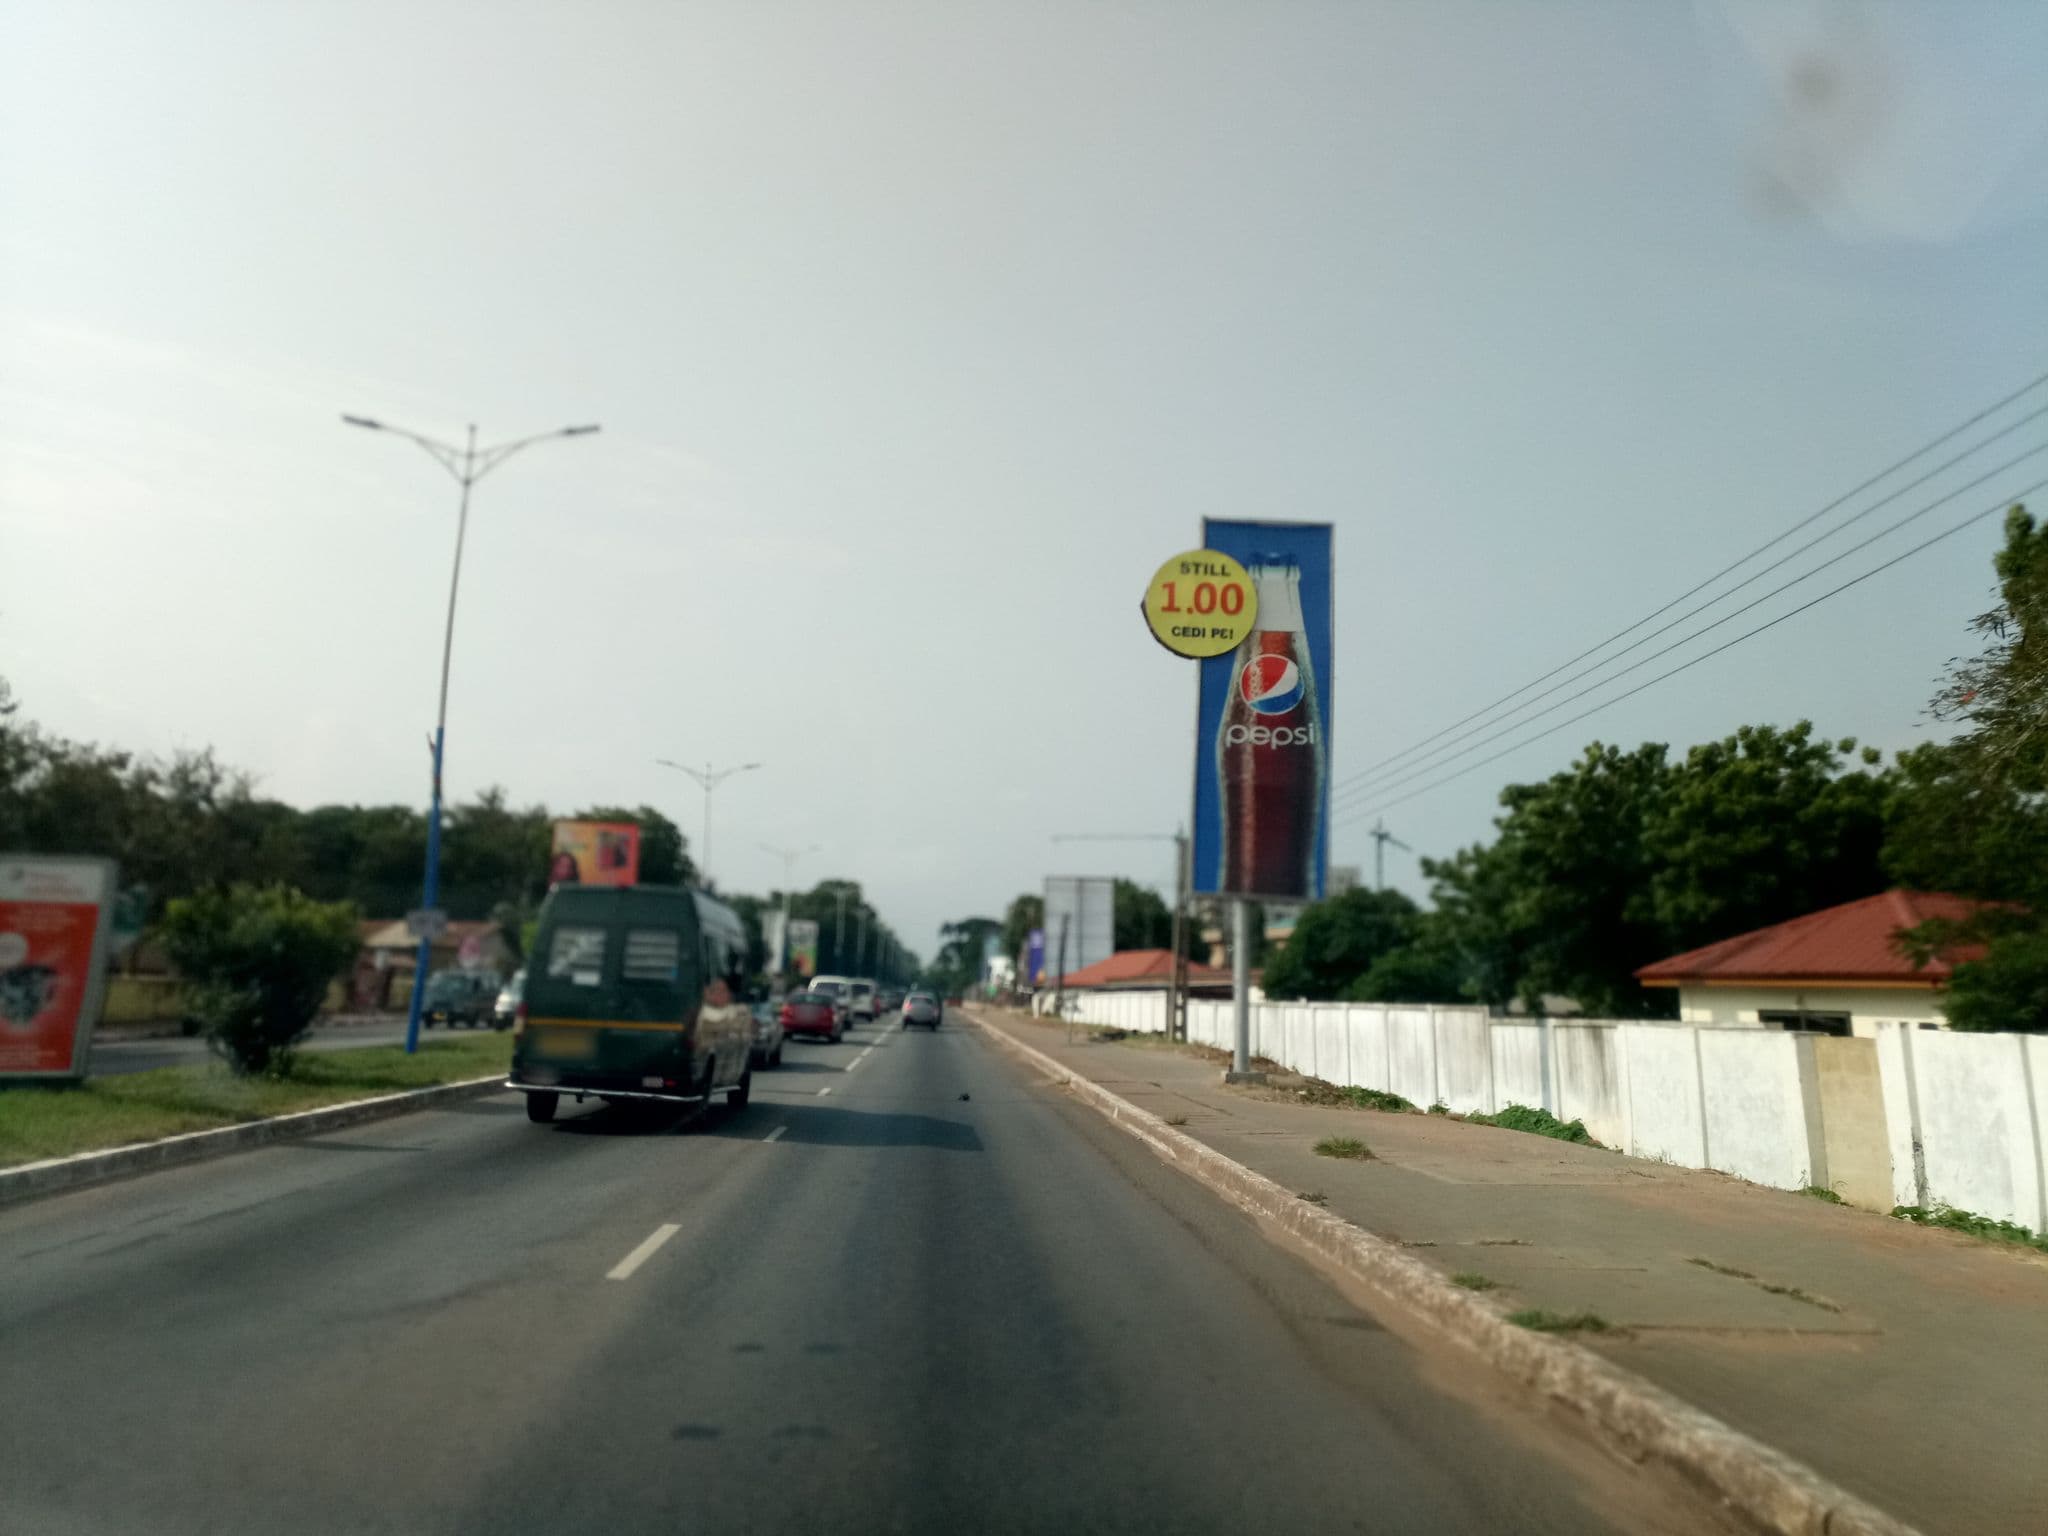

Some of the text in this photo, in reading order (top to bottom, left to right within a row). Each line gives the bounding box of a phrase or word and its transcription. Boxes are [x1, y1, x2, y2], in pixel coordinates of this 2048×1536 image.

[1181, 561, 1231, 576] STILL
[1161, 581, 1245, 615] 1.00
[1171, 626, 1206, 638] CEDI
[1225, 723, 1315, 749] pepsi
